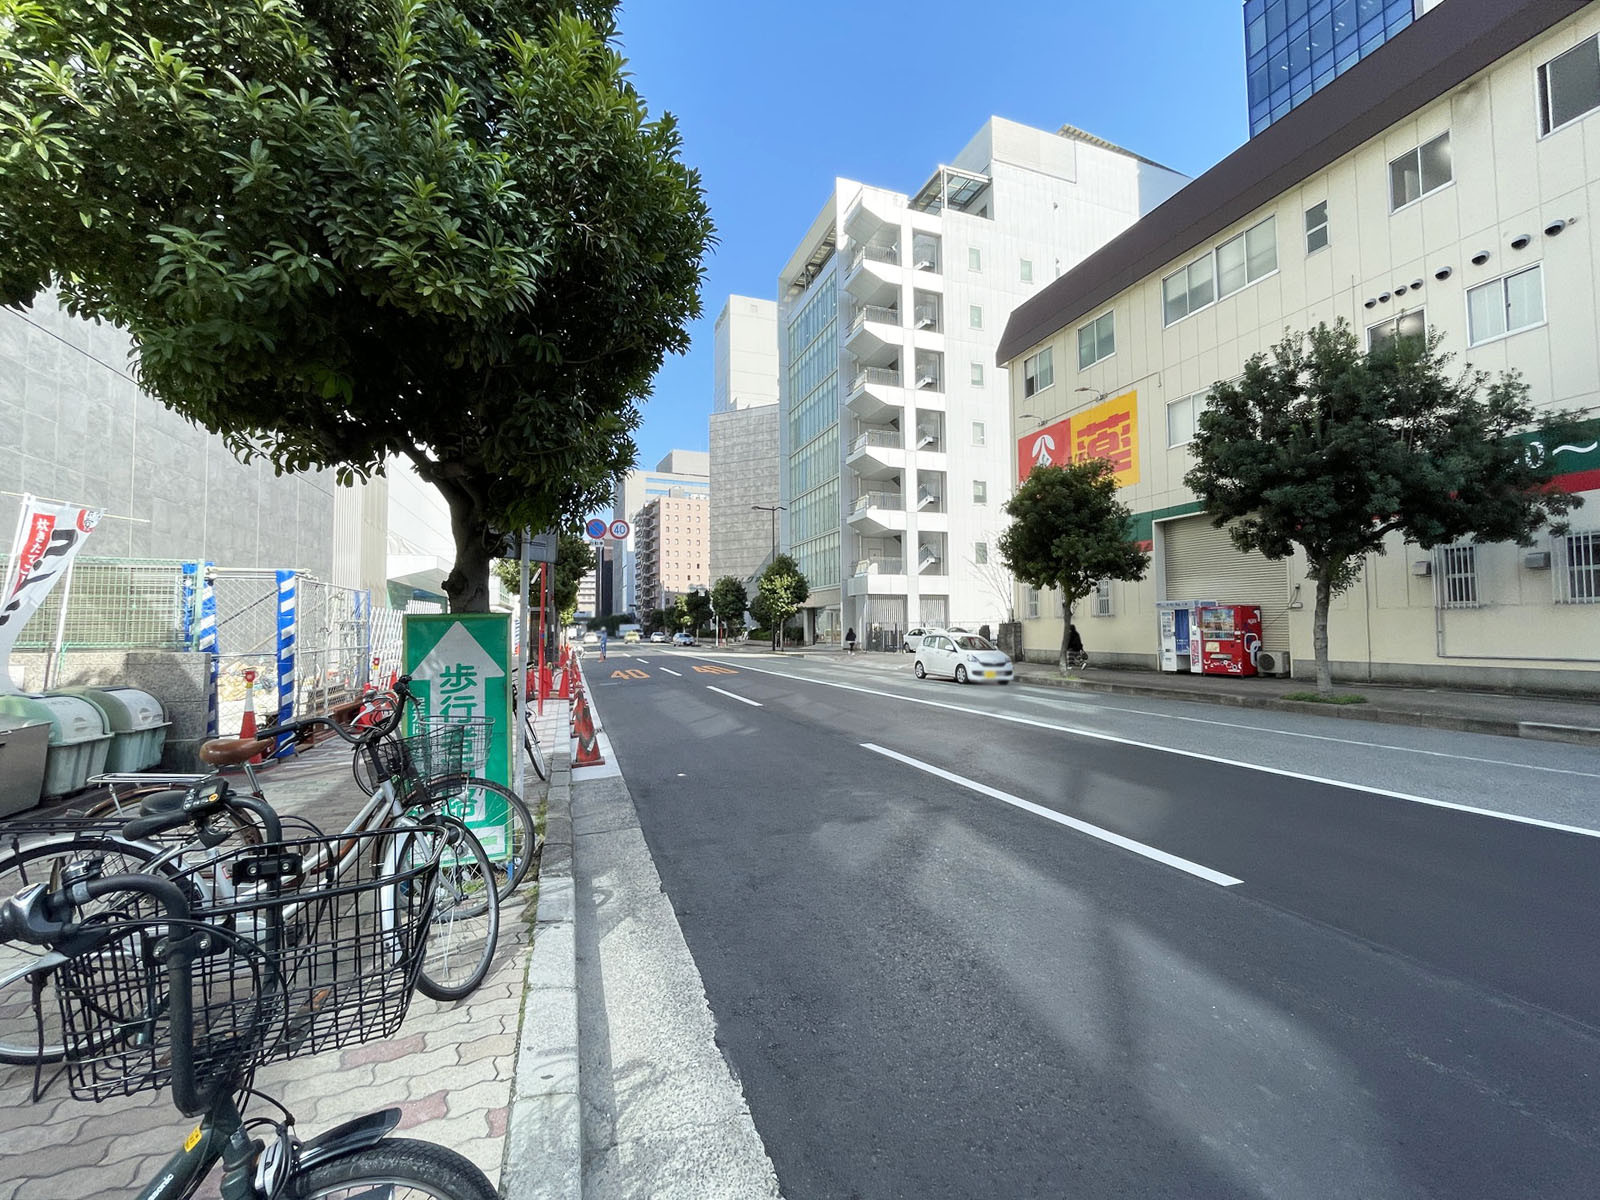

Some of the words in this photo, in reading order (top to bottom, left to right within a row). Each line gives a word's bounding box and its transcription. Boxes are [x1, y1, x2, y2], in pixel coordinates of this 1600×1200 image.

[614, 524, 626, 535] 40
[611, 668, 651, 680] 40
[691, 665, 740, 675] 40
